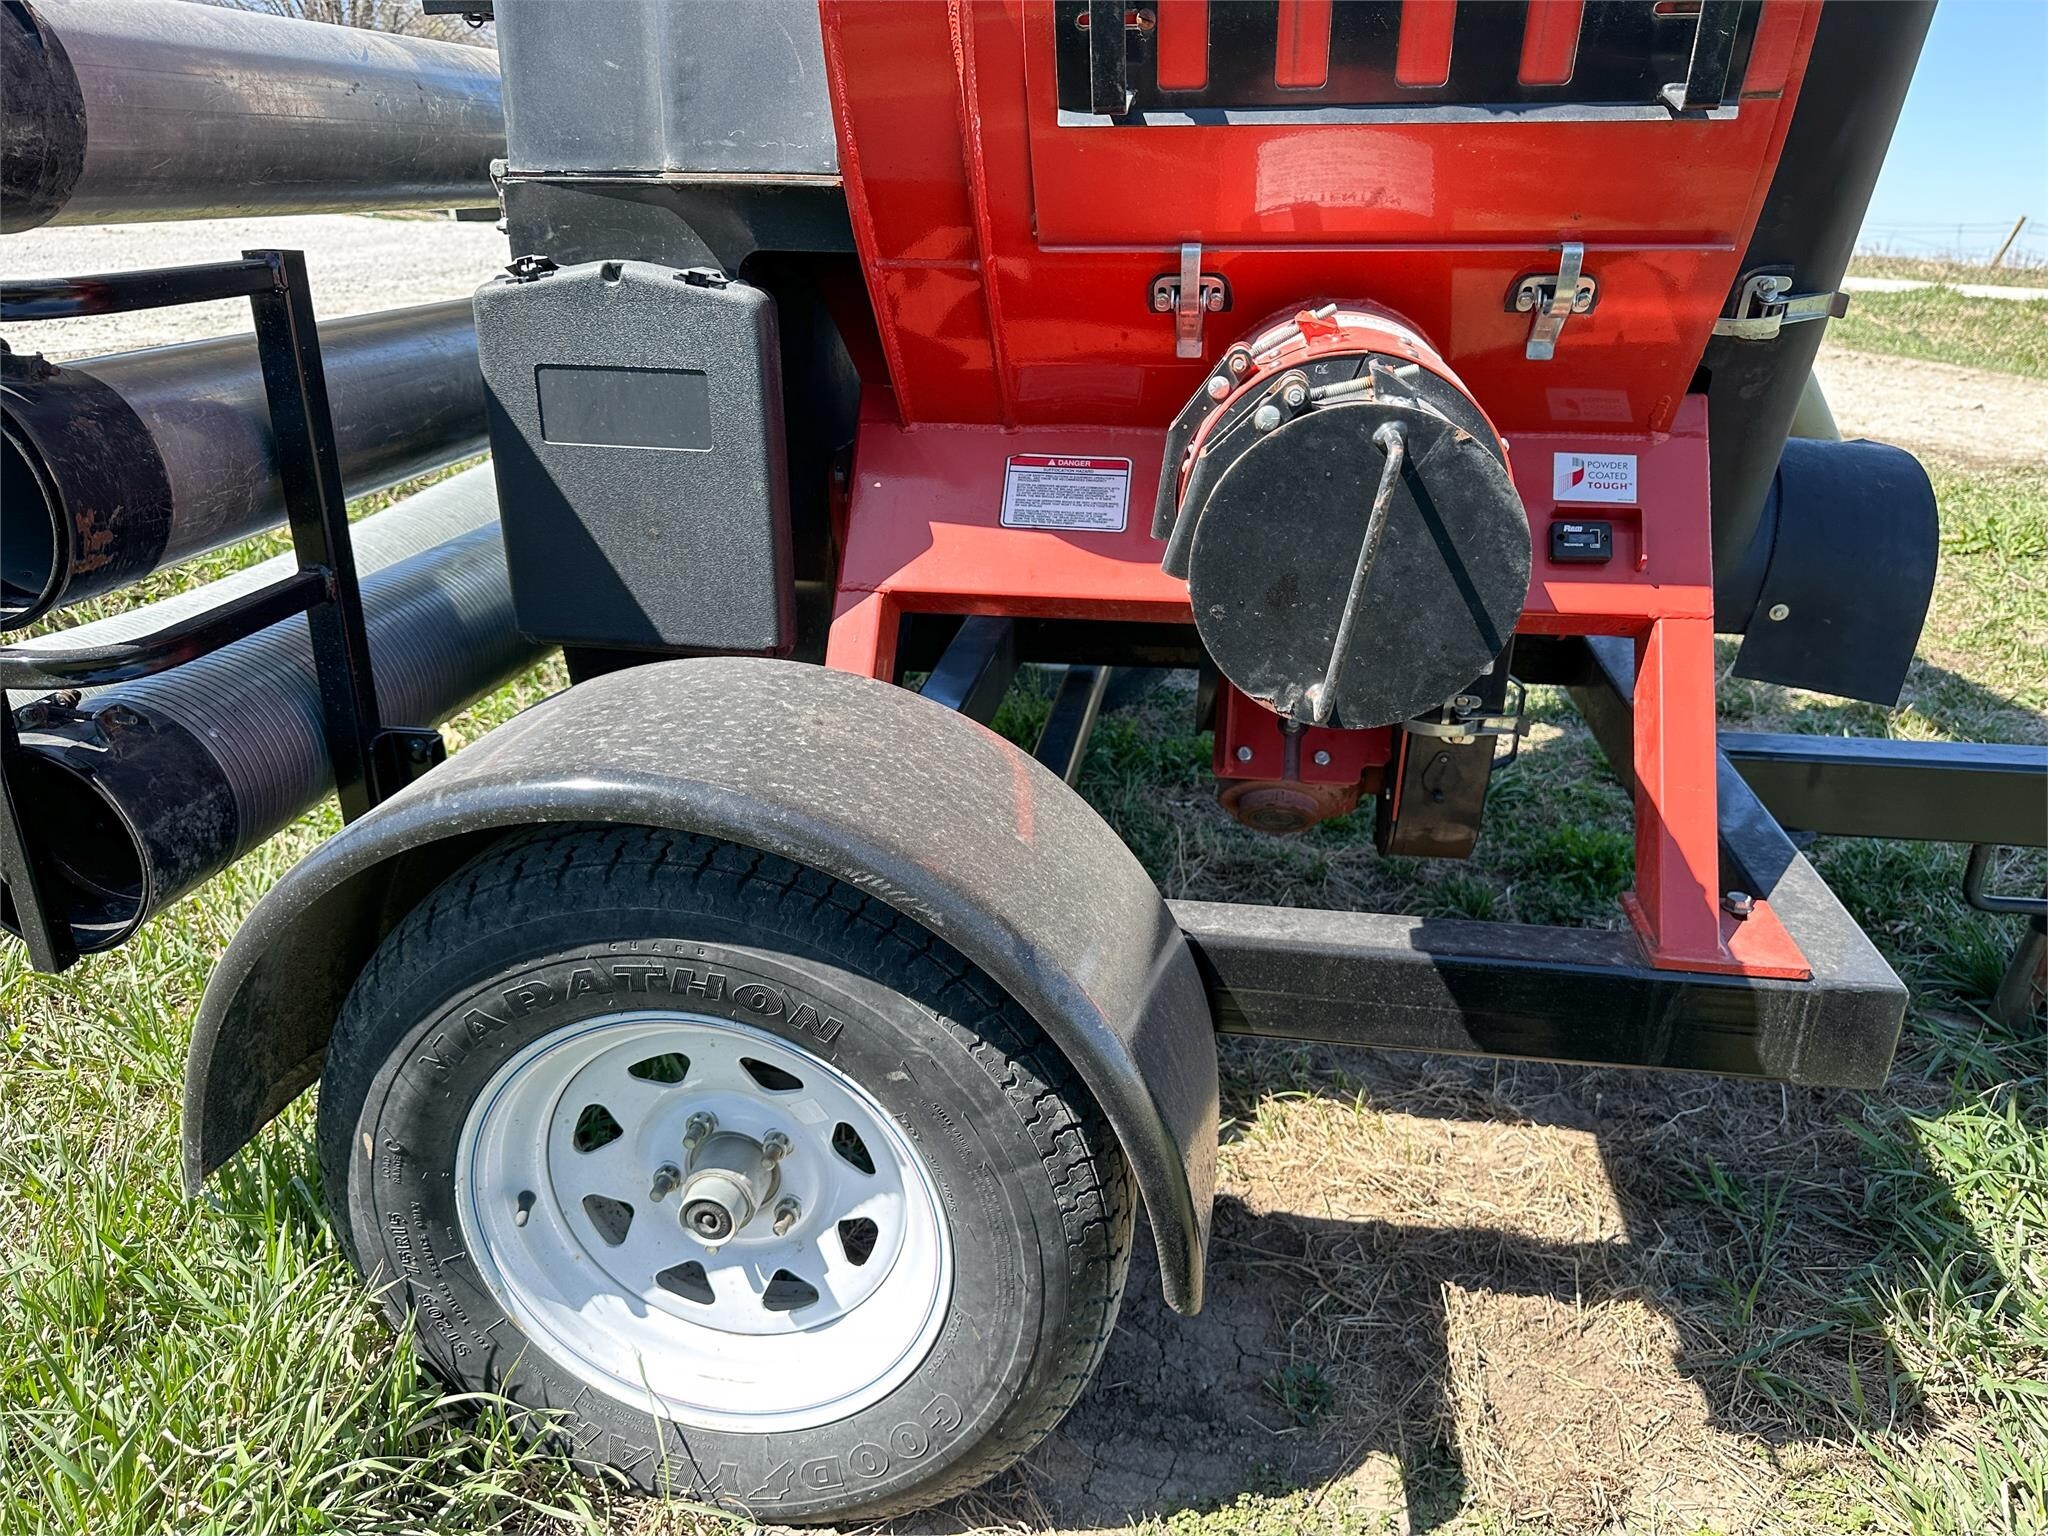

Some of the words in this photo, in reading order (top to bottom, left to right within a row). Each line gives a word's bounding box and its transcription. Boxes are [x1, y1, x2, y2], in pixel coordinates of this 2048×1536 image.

[1058, 459, 1092, 468] DANGER
[1587, 461, 1628, 470] POWDER
[1588, 471, 1628, 480] COATED
[417, 964, 844, 1081] MARATHON
[549, 1392, 964, 1501] GOODYEAR
